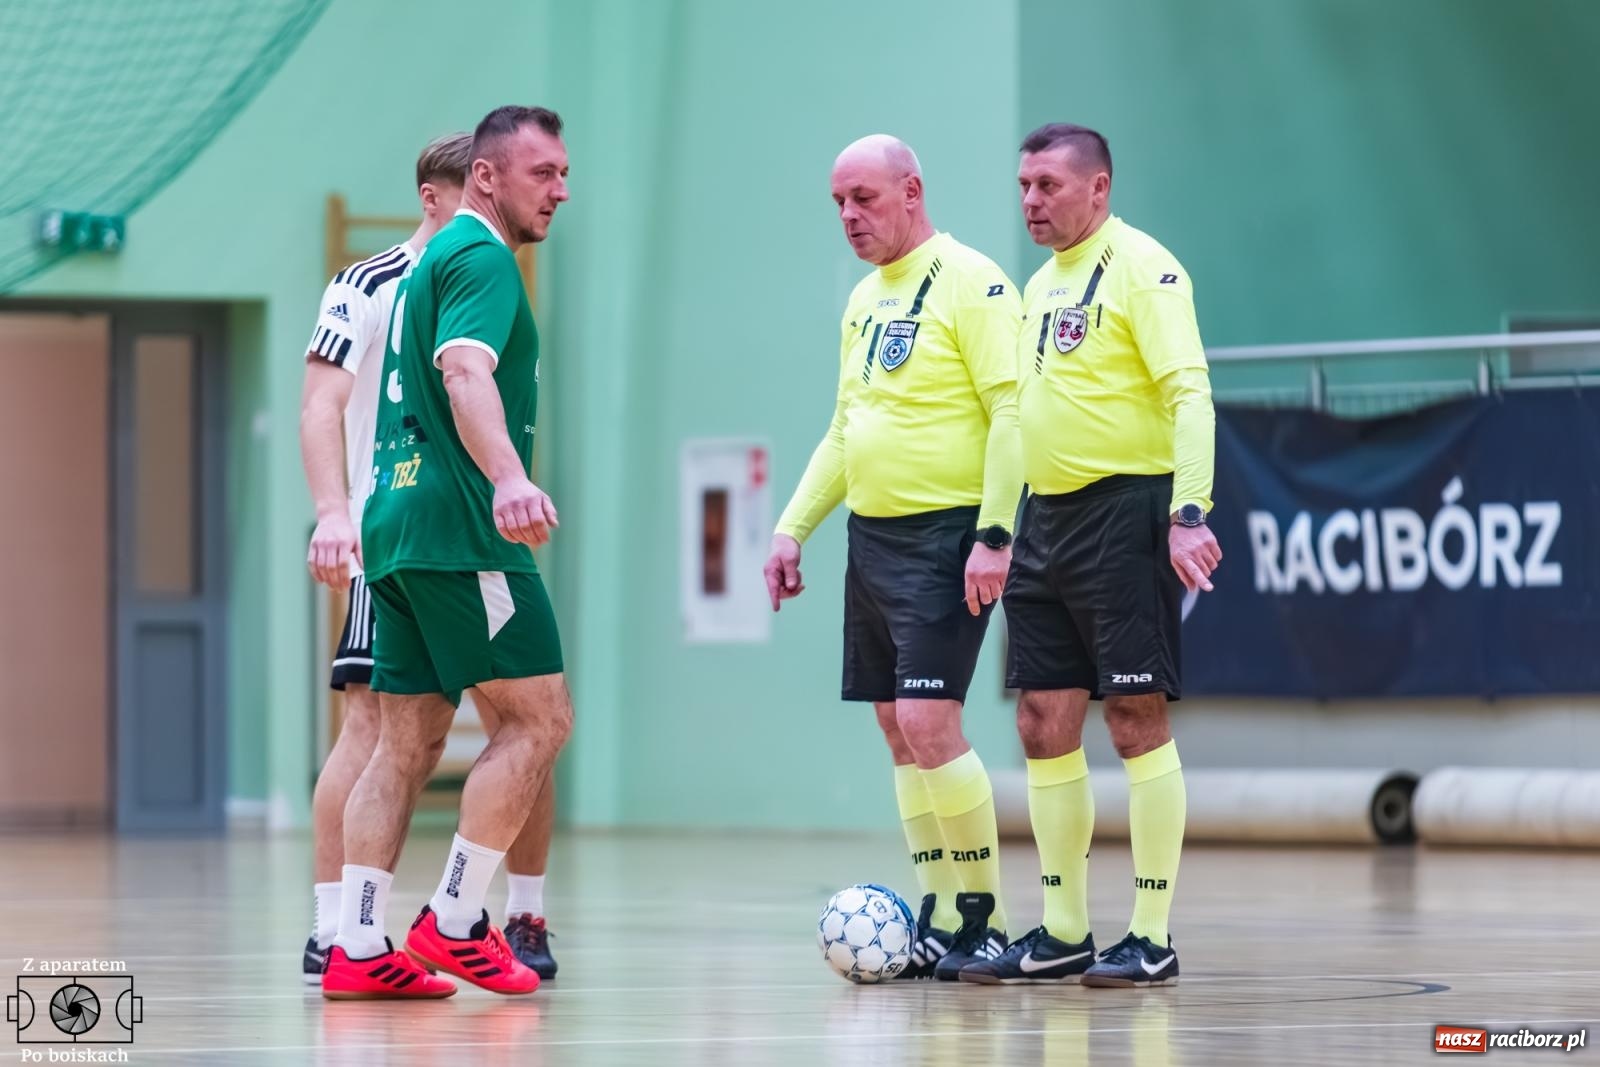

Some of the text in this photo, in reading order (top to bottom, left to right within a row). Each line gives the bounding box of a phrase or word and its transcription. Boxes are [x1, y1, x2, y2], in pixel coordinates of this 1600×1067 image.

[390, 453, 422, 491] TBŻ
[1247, 476, 1563, 594] RACIBÓRZ
[903, 678, 945, 689] zina
[1111, 673, 1153, 684] zina
[911, 847, 943, 865] ina
[950, 846, 991, 863] zina
